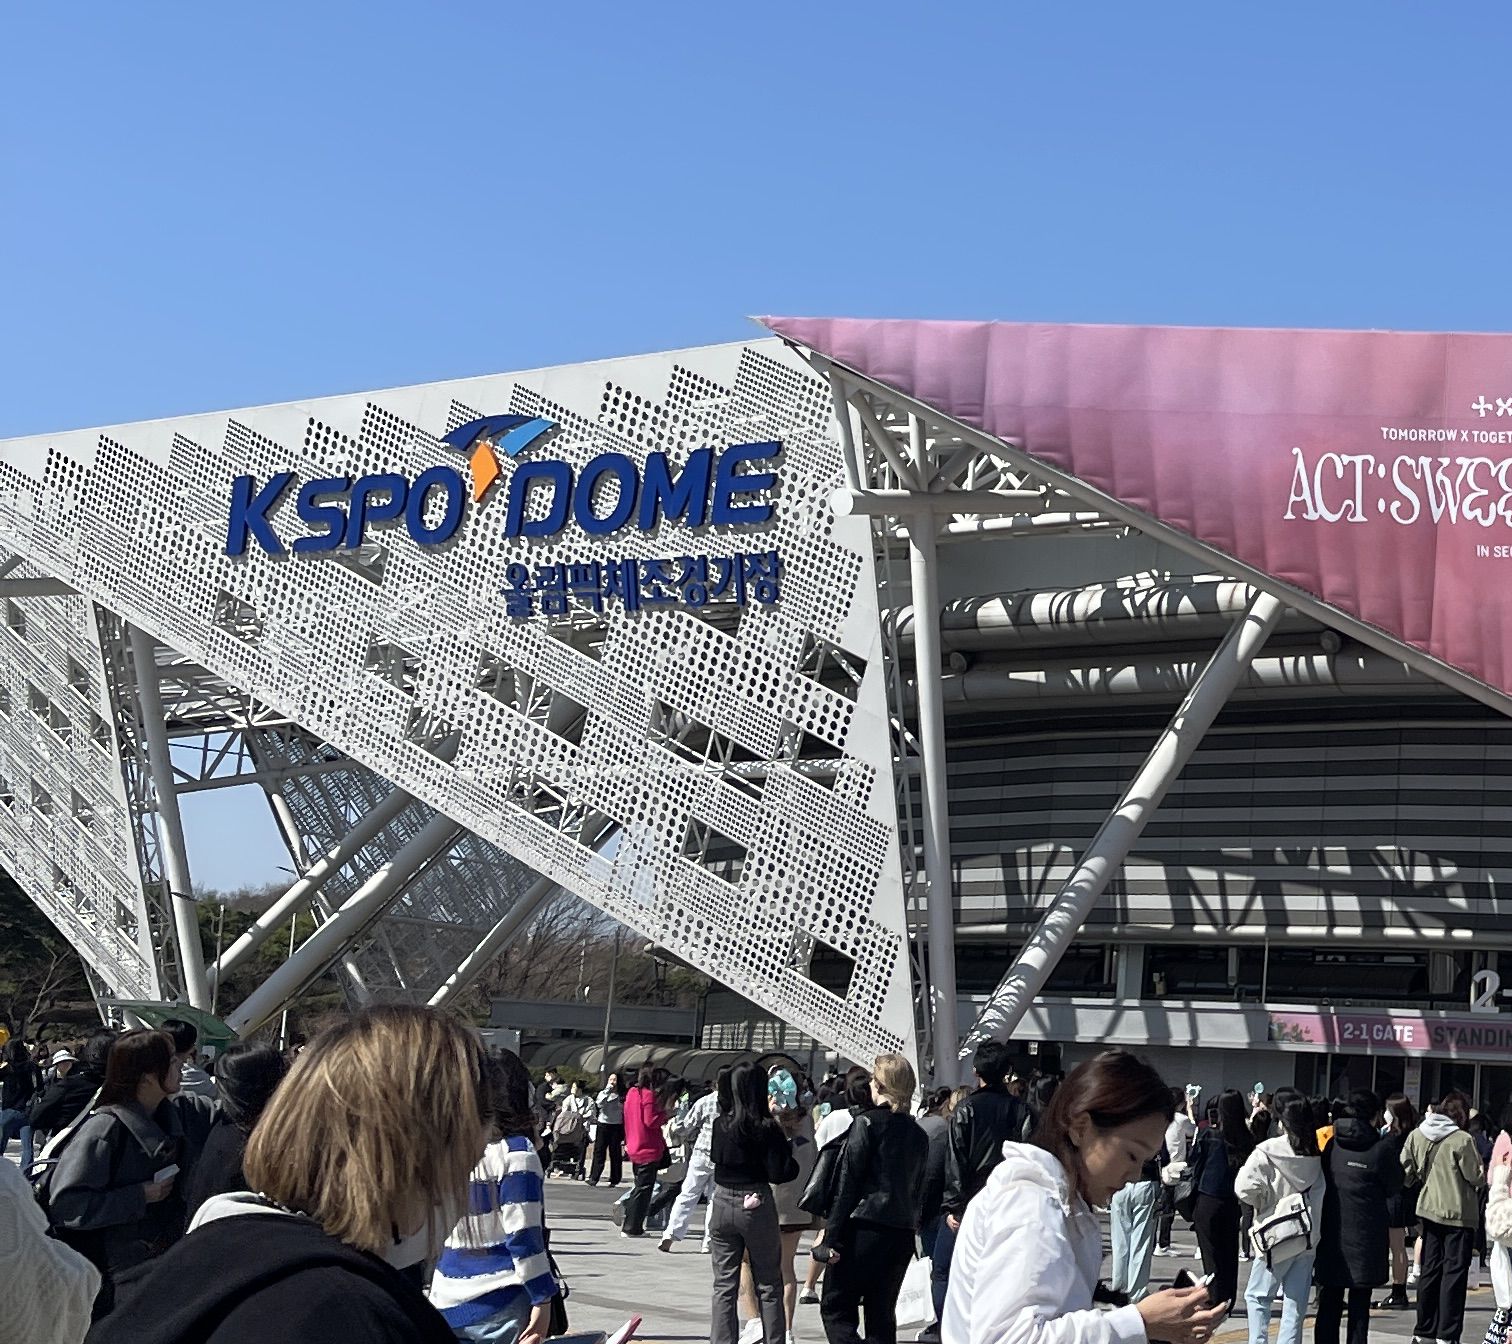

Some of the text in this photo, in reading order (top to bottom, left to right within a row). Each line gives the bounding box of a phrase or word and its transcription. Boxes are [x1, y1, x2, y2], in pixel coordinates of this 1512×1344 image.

[1380, 426, 1458, 442] TOMORROW
[1460, 429, 1469, 442] X
[225, 441, 782, 557] KSPO DOME
[1476, 544, 1490, 557] IN
[503, 552, 781, 617] 올림픽체조경기장
[1343, 1022, 1369, 1040] 2-1
[1372, 1023, 1414, 1042] GATE
